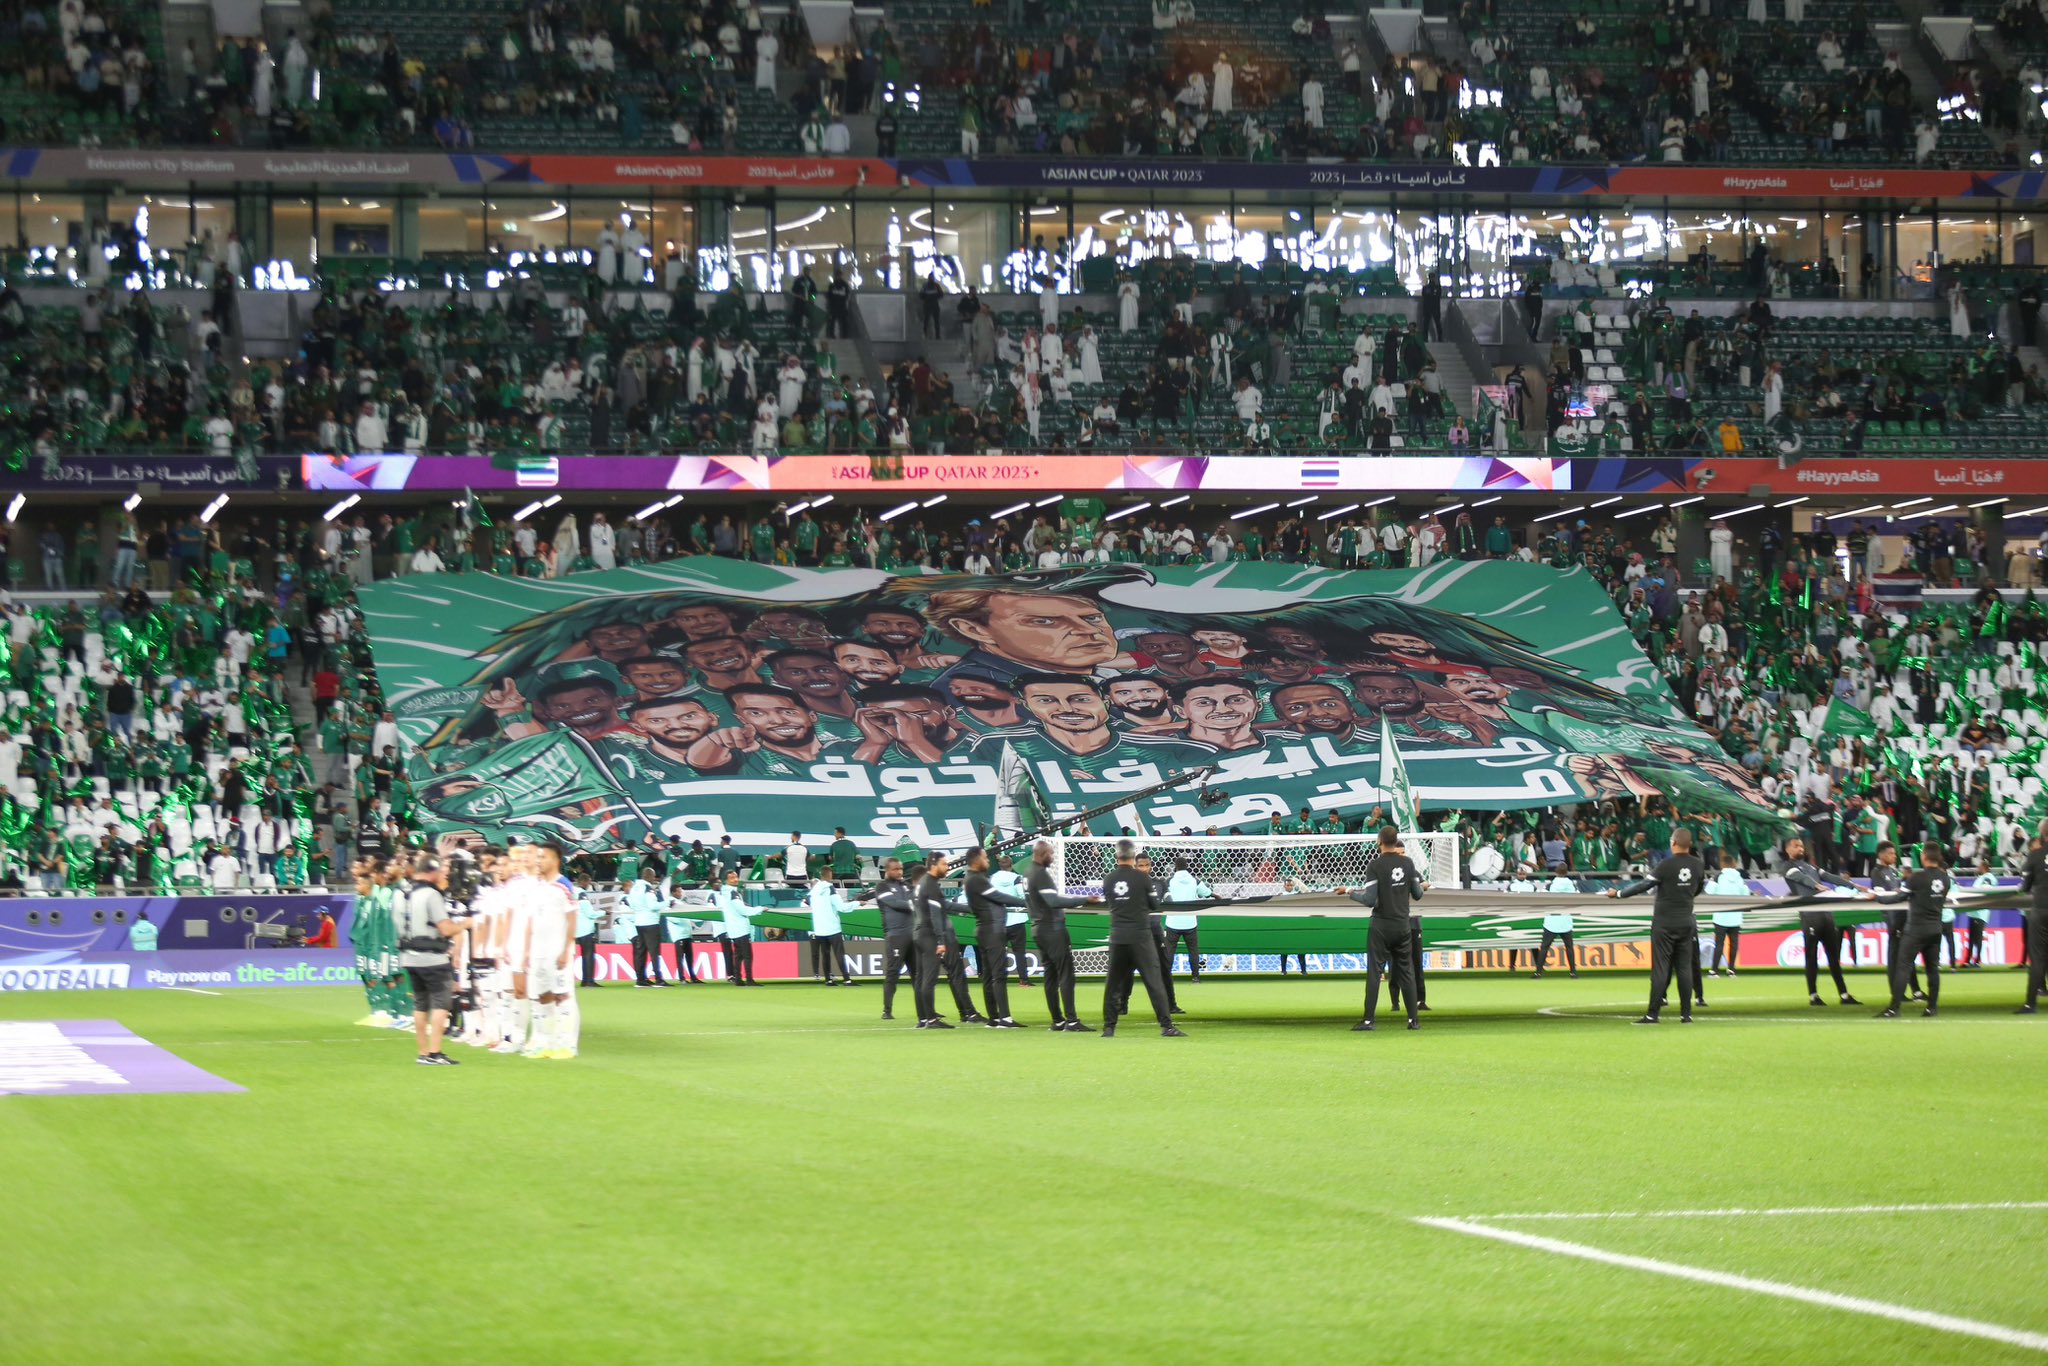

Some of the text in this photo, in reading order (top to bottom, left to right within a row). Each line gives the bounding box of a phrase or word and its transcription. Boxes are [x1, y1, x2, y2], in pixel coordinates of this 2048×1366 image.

[86, 157, 235, 174] Education City Stadium
[1048, 168, 1088, 180] ASIAN
[1090, 168, 1117, 180] CUP
[1127, 170, 1169, 183] QATAR
[1723, 177, 1787, 189] #HayyaAsia
[839, 466, 891, 479] ASIAN
[895, 466, 929, 479] CUP
[934, 466, 987, 481] QATAR
[992, 466, 1030, 479] 2023
[1797, 469, 1879, 485] #HayyaAsia
[572, 952, 728, 981] ONAMI
[1, 969, 121, 990] OOTBALL
[146, 969, 231, 986] Play now on
